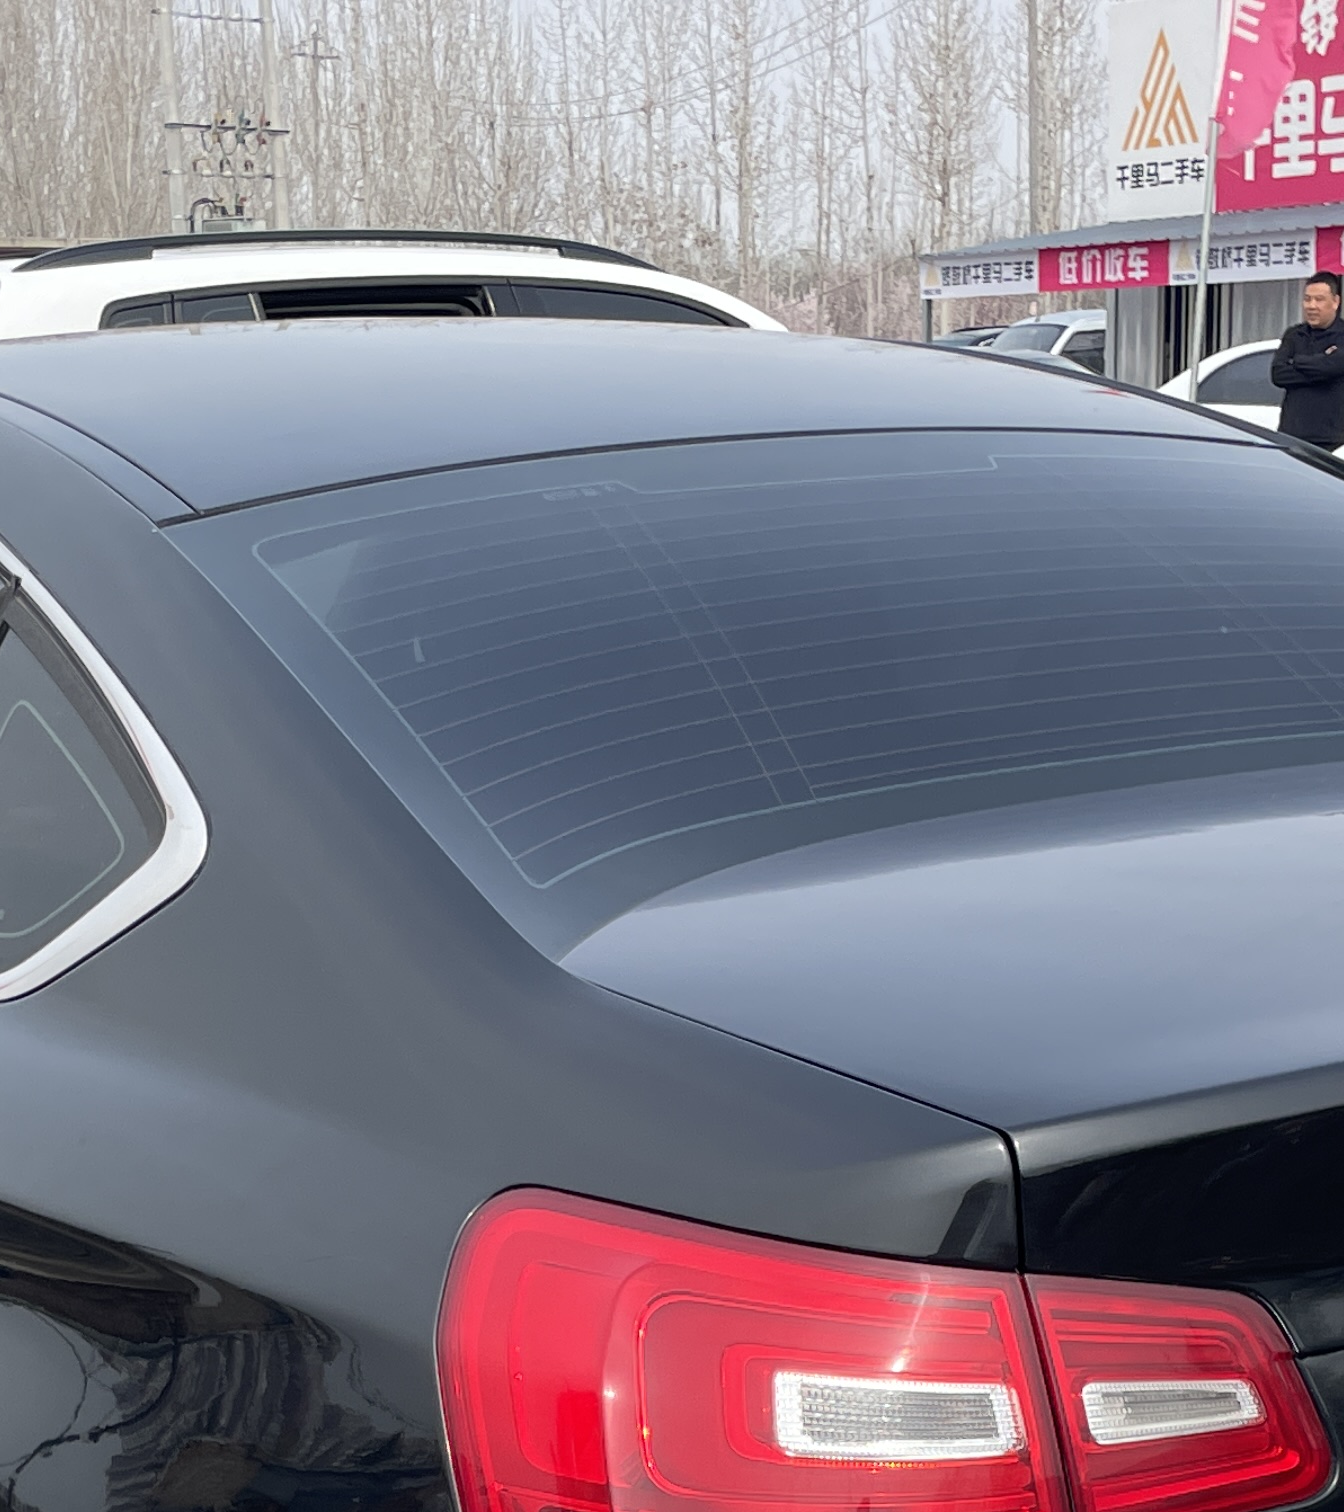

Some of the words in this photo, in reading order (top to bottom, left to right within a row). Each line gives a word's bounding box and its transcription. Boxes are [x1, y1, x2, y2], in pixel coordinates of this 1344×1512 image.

[1116, 157, 1205, 190] 千里马二手车
[1058, 246, 1149, 285] 低价收车
